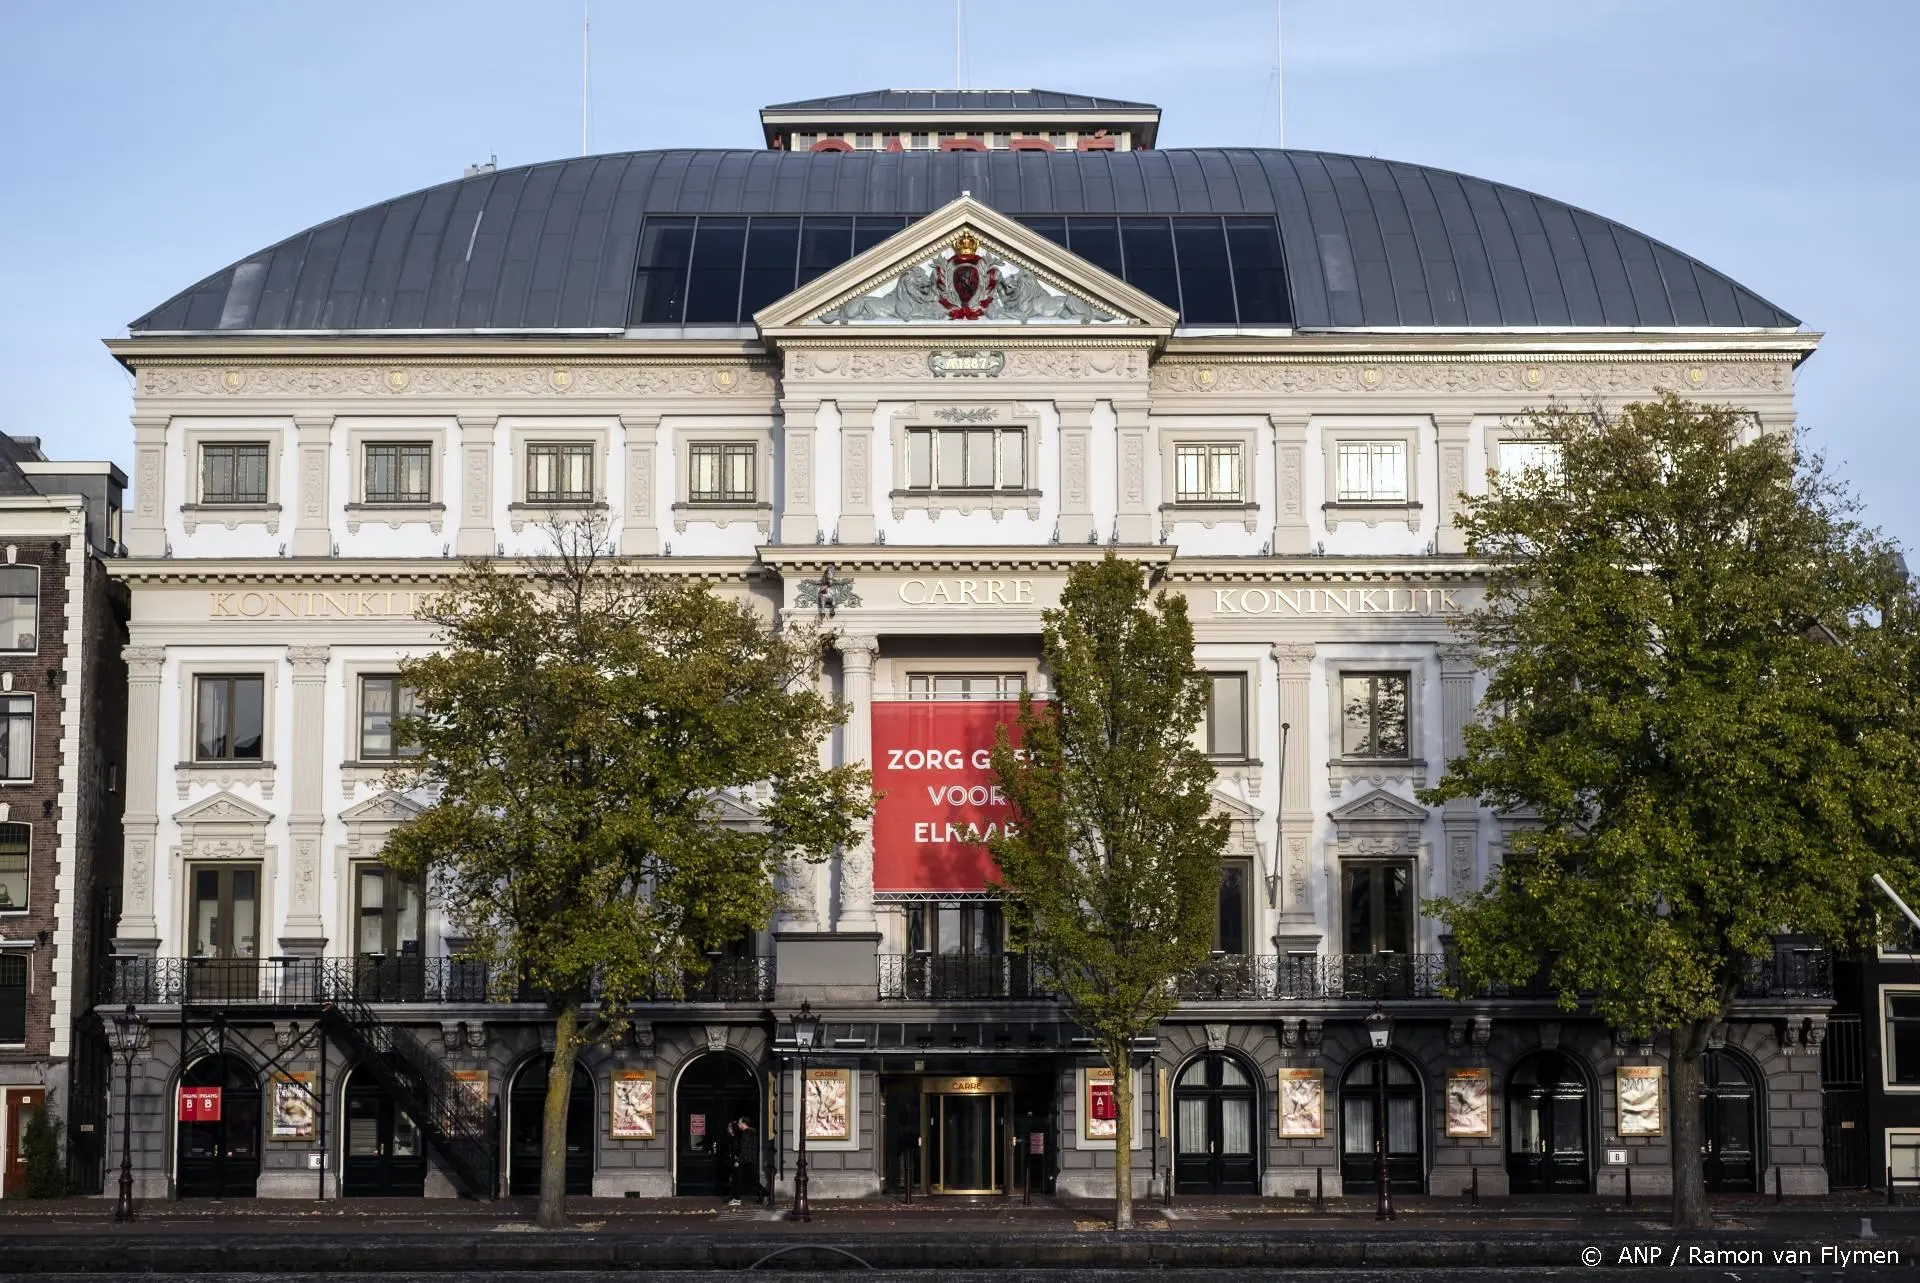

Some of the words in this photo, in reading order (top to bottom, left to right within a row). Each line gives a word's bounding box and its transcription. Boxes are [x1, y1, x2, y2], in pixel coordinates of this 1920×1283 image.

[1212, 588, 1465, 617] KONINKLIJK
[887, 749, 964, 770] ZORG
[927, 785, 1006, 806] VOOR
[186, 1099, 193, 1109] B
[204, 1099, 213, 1109] B
[1096, 1097, 1104, 1106] A
